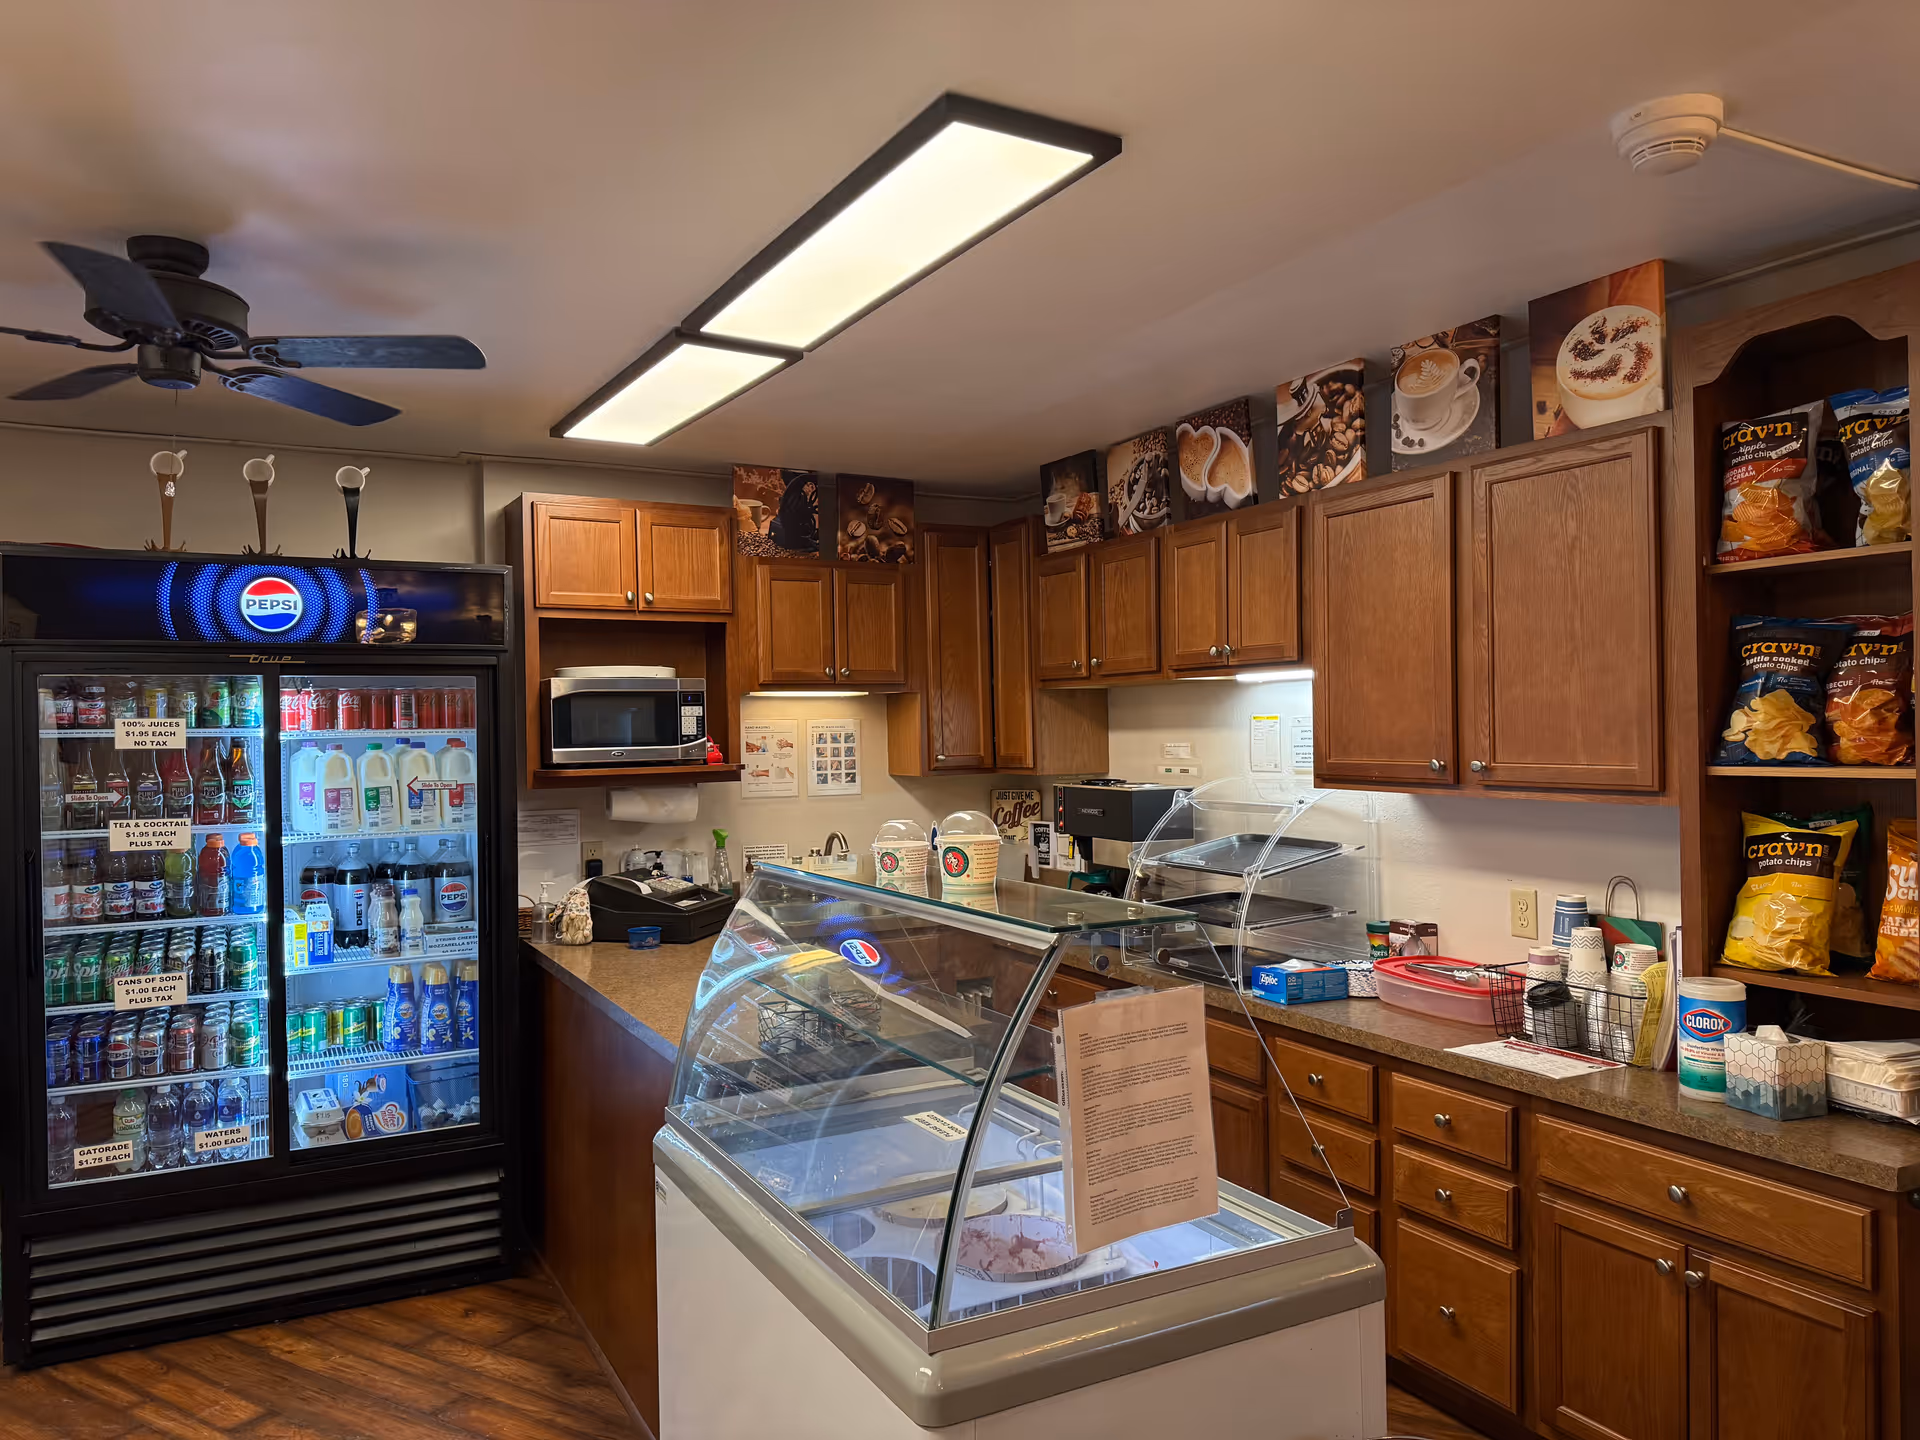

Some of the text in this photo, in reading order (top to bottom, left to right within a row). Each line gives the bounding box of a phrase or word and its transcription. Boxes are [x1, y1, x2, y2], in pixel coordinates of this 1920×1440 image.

[1722, 420, 1792, 451] crav'n
[1731, 449, 1772, 466] potato chip
[1850, 445, 1871, 459] potato
[1733, 470, 1756, 482] CREAM
[246, 598, 298, 611] PEPSI
[1742, 642, 1815, 658] crav'n
[1745, 654, 1810, 666] kettle cooked
[1860, 656, 1887, 667] chips
[1752, 662, 1798, 672] potato chips
[125, 730, 150, 738] $1.95
[996, 791, 1034, 800] JUST GIVE ME
[993, 800, 1040, 829] Coffee
[1748, 842, 1823, 859] crav'n
[1759, 857, 1812, 869] potato chips
[1886, 862, 1918, 901] SU
[441, 893, 468, 901] PEPSI
[1898, 887, 1918, 901] CH
[117, 978, 142, 986] CANS
[1260, 972, 1279, 986] Ziploc
[125, 984, 176, 996] $1.00 EACH
[129, 996, 152, 1004] PLUS
[1686, 1014, 1724, 1031] CLOROX
[386, 1104, 398, 1128] Coffee
[204, 1128, 241, 1139] WATERS
[198, 1136, 248, 1149] $1.00 EACH
[79, 1143, 130, 1156] GATORADE
[78, 1152, 131, 1167] $1.75 EACH
